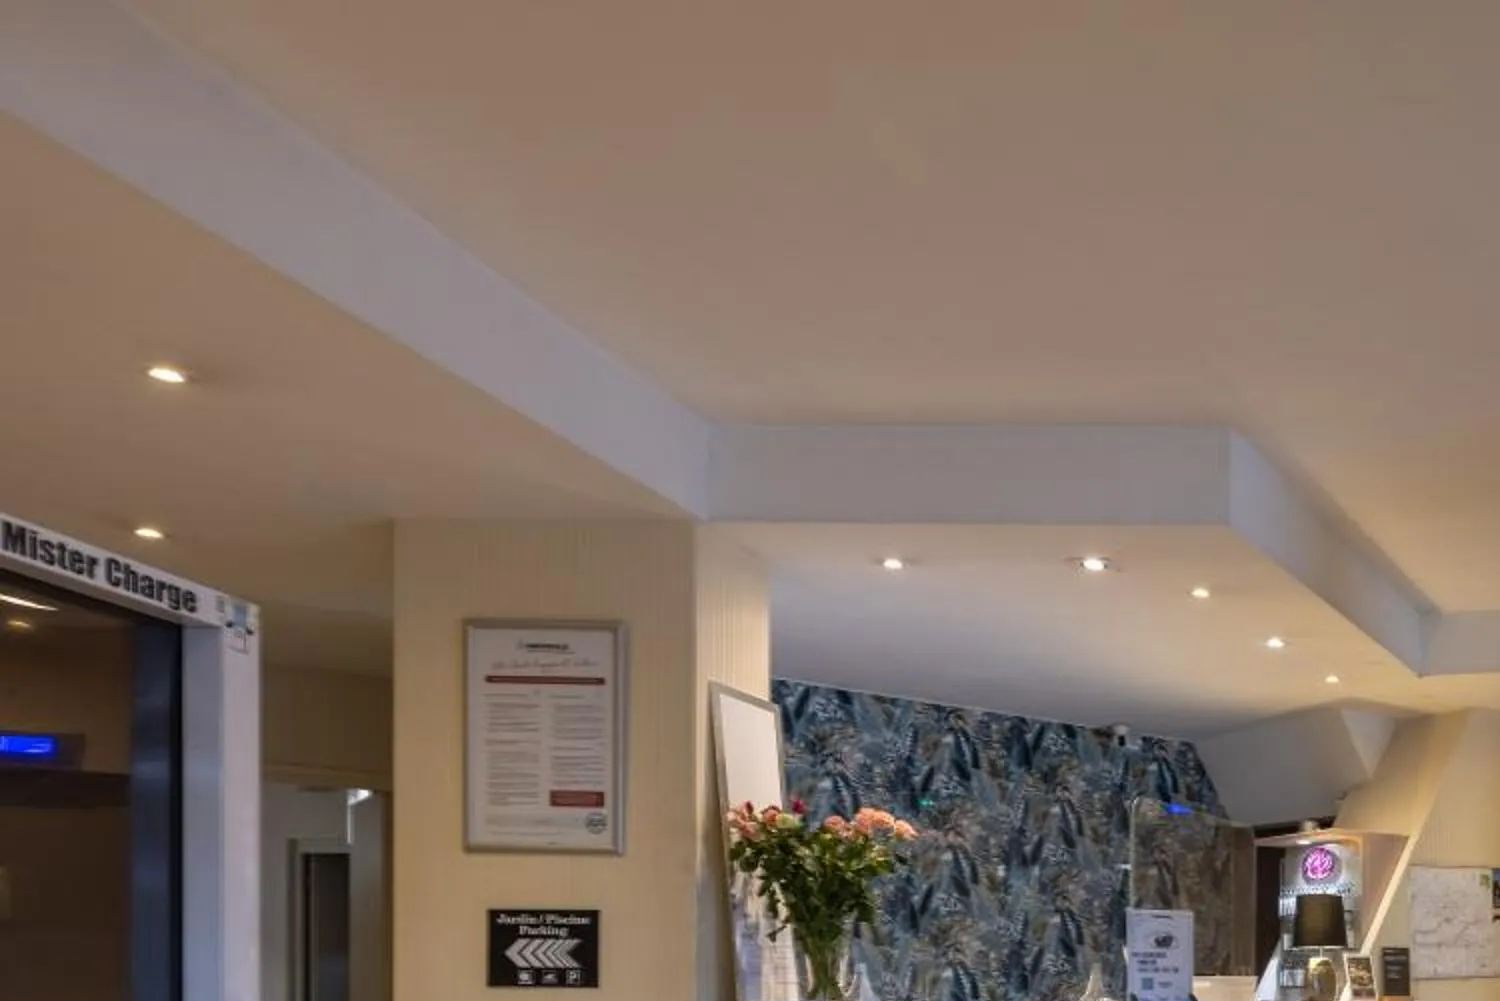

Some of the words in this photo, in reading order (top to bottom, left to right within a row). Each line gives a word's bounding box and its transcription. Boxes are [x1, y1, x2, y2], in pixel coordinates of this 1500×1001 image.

[1, 521, 98, 579] Mister
[105, 558, 197, 612] Charge
[519, 926, 568, 937] Parking
